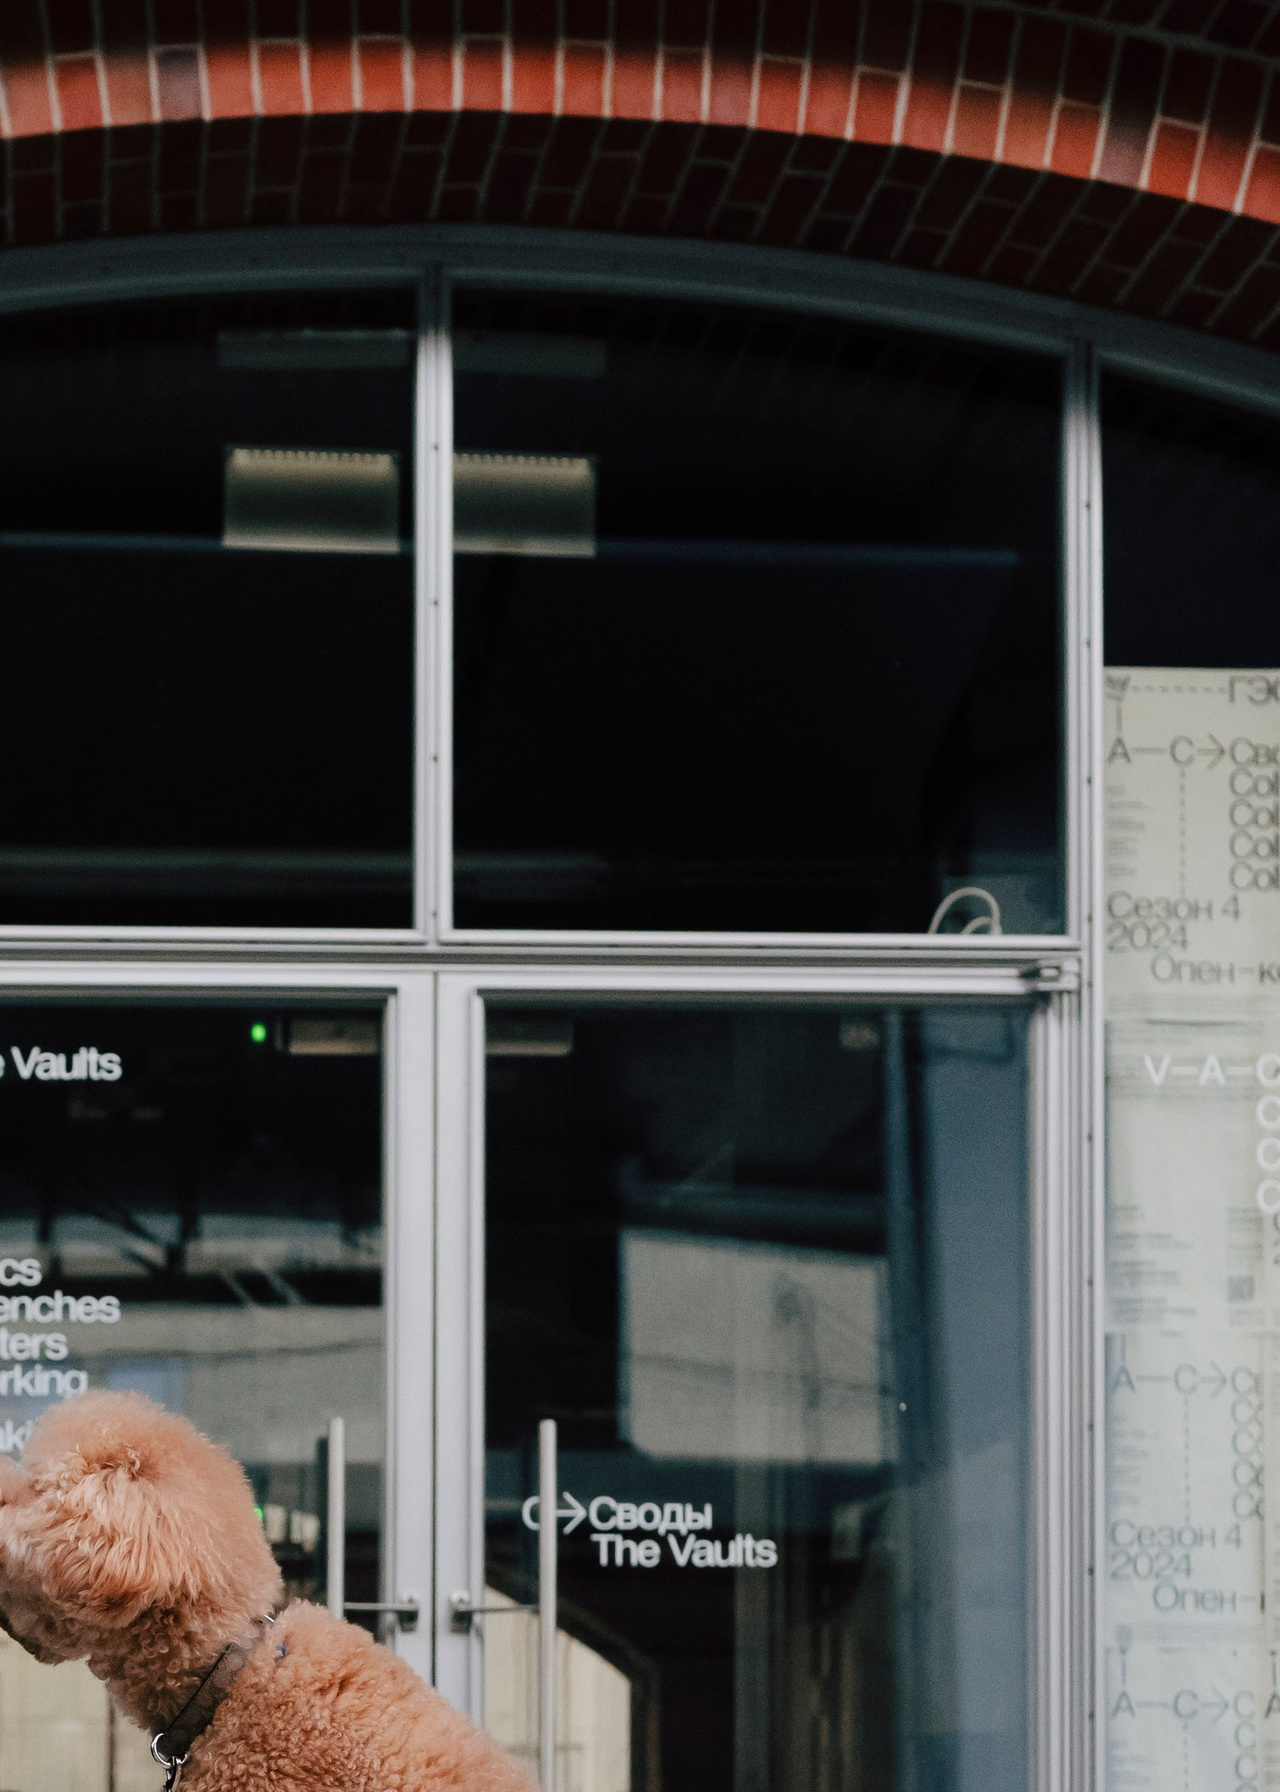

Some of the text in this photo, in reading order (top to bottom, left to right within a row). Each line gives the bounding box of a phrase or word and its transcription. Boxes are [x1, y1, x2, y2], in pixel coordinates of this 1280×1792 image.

[1108, 890, 1240, 921] Сезон 4
[1108, 922, 1189, 952] 2024
[11, 1045, 124, 1082] Vaults
[588, 1495, 713, 1536] Своды
[590, 1532, 779, 1568] The Vaults
[1109, 1519, 1242, 1549] Сезон 4
[1110, 1549, 1192, 1581] 2024
